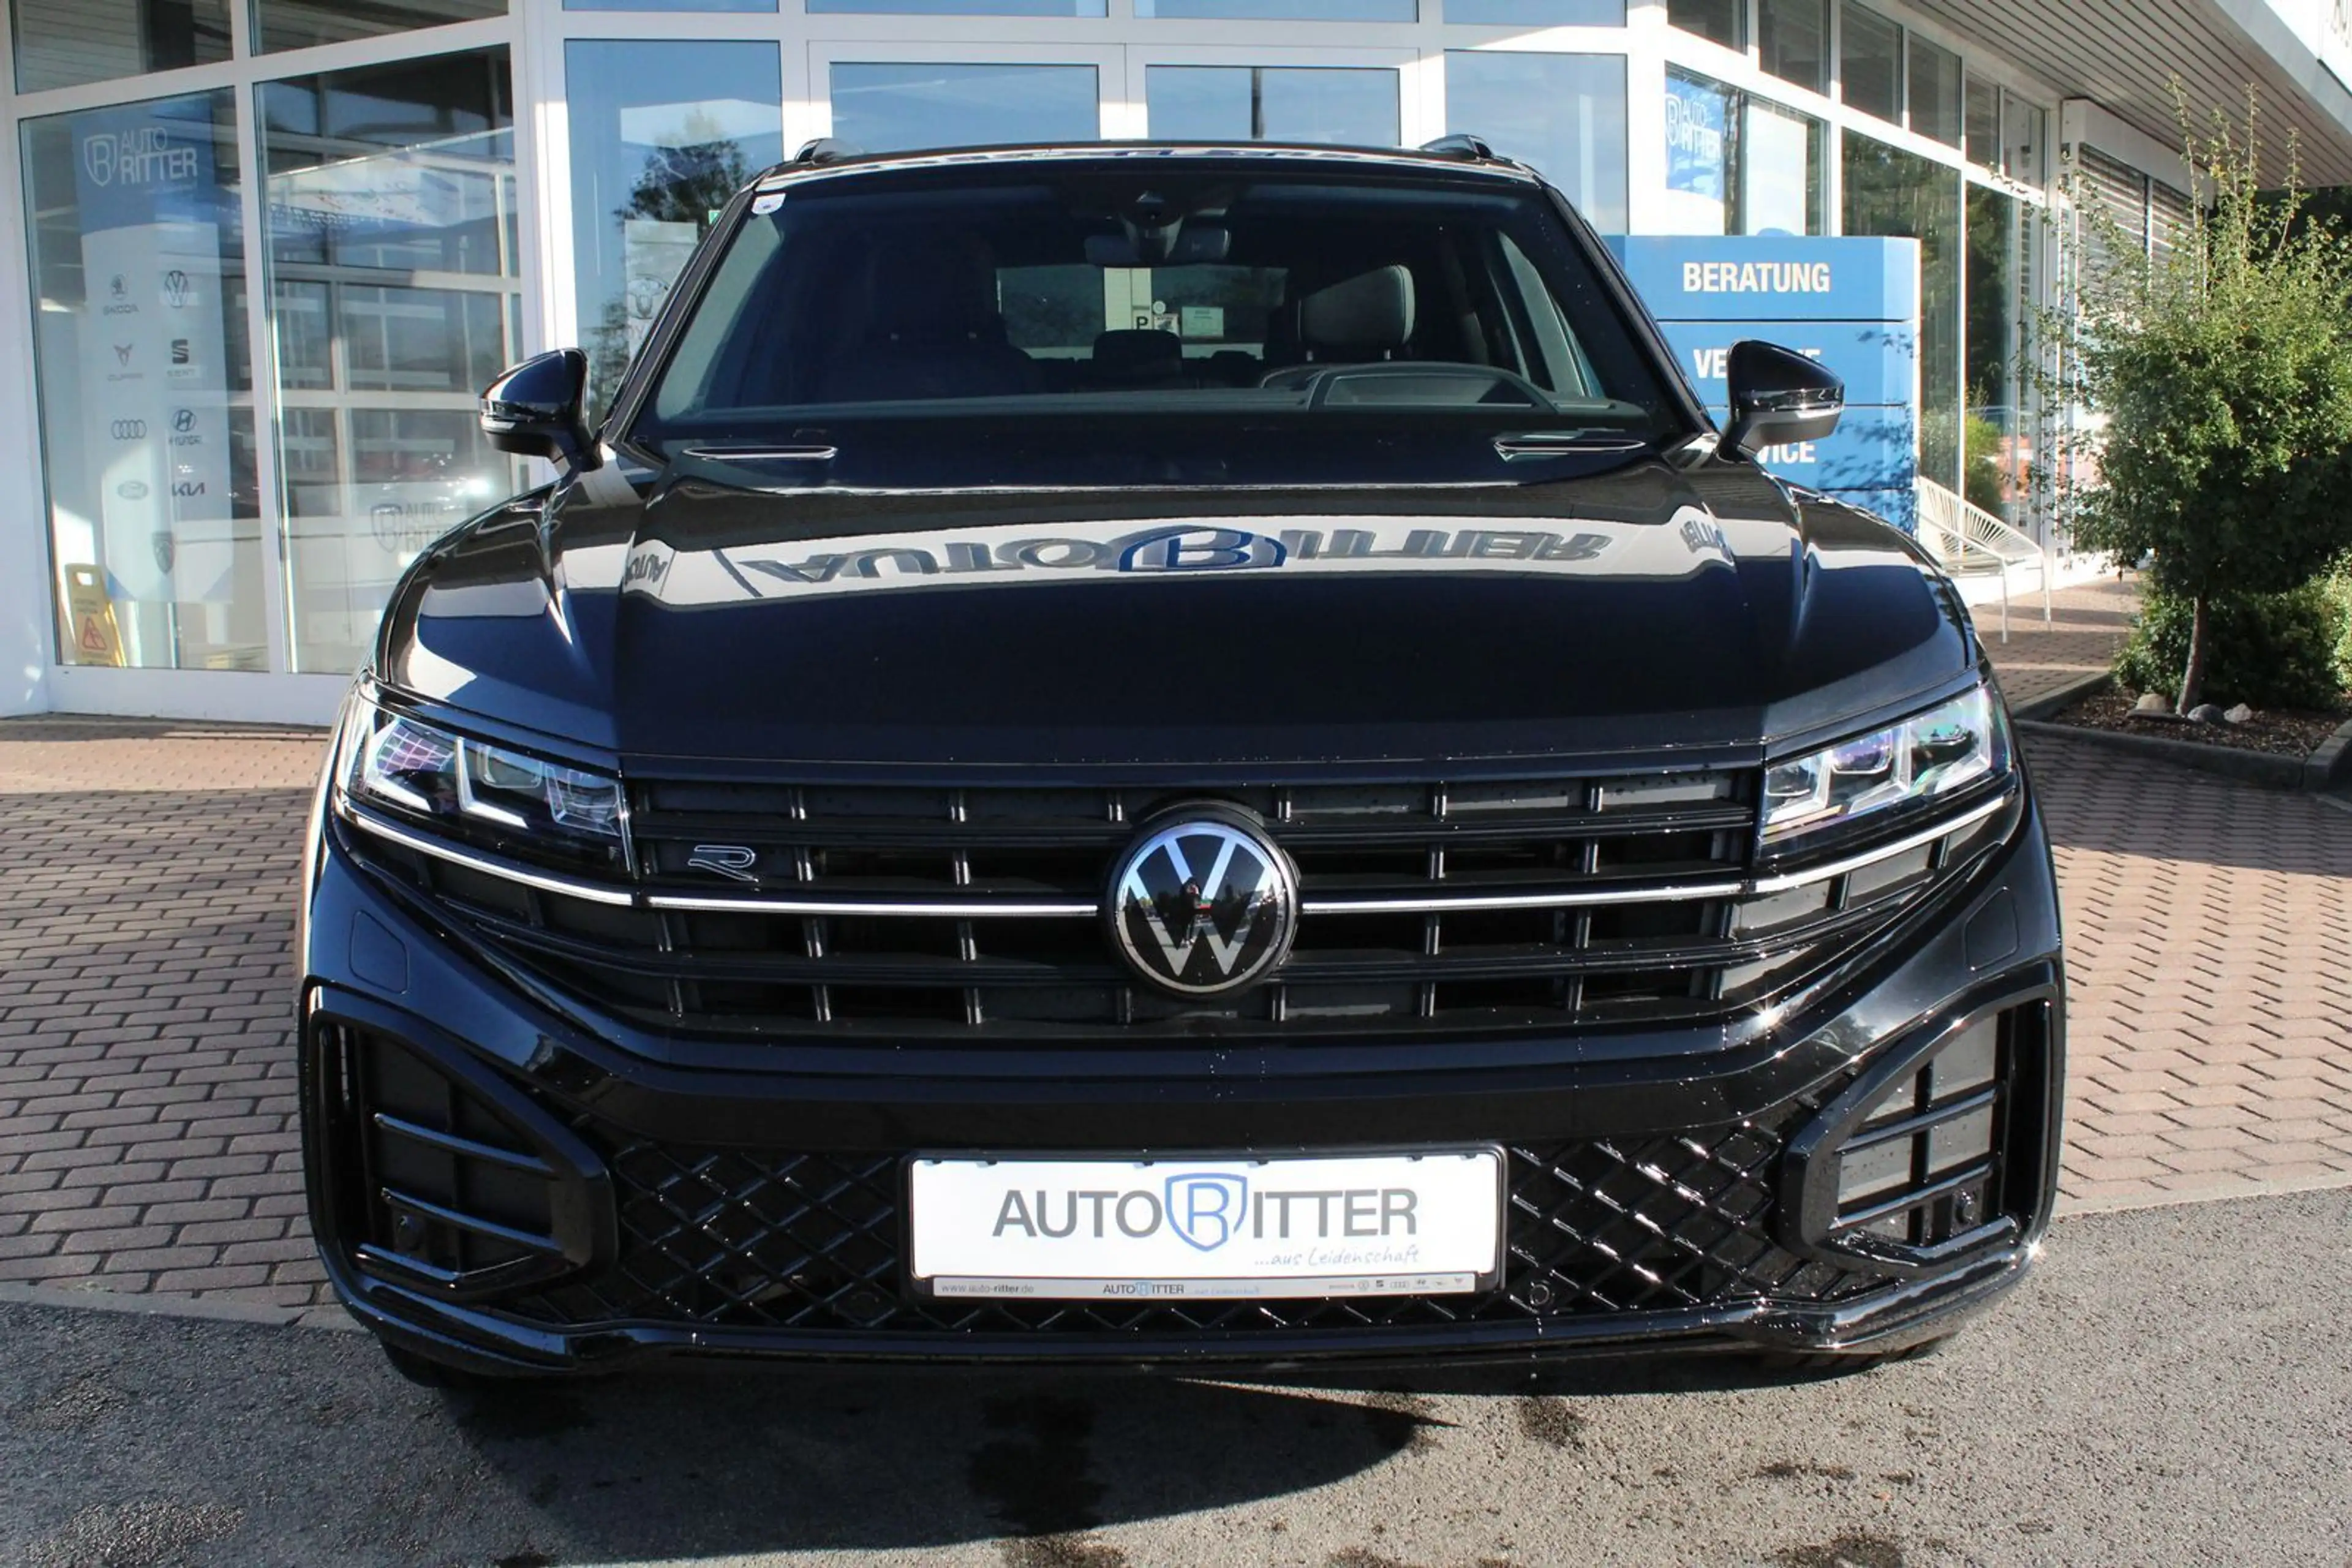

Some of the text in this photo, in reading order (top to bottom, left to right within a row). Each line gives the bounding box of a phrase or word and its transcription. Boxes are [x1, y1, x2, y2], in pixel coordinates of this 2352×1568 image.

[121, 127, 168, 153] AUTO
[120, 148, 198, 184] RITTER
[1683, 263, 1830, 292] BERATUNG
